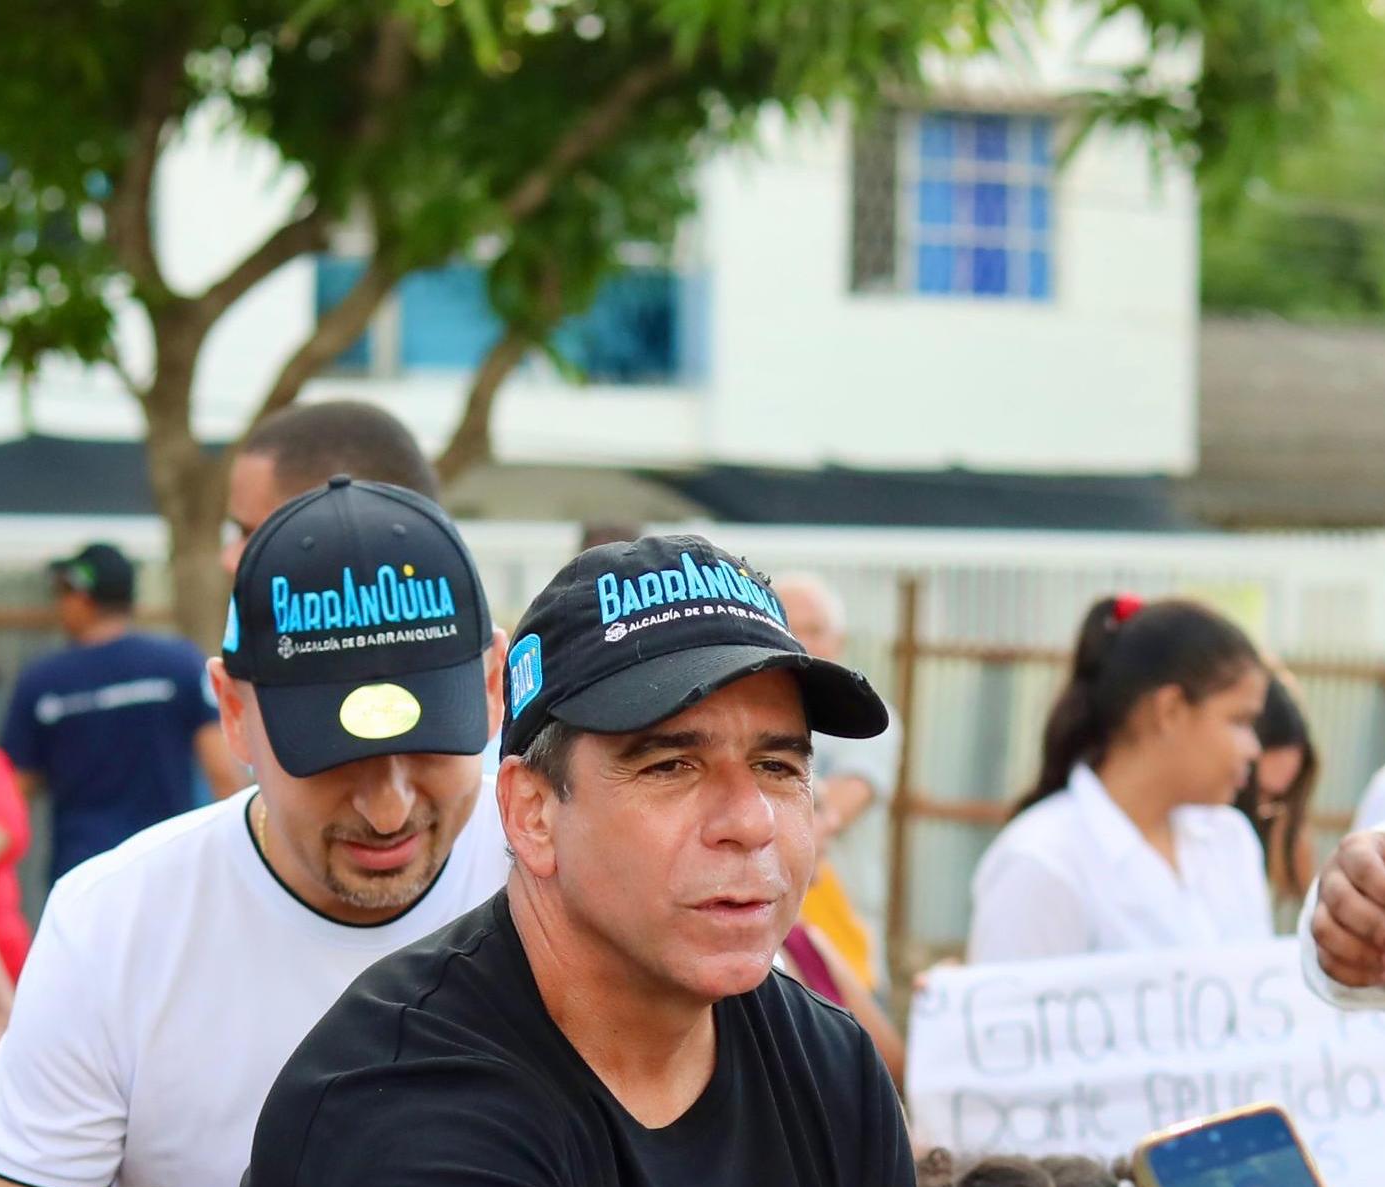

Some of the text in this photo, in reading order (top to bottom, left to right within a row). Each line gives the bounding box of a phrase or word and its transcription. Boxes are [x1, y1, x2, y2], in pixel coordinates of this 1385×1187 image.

[598, 552, 786, 625] BARRANQUILL
[342, 636, 355, 649] DE
[356, 623, 457, 648] BARRANQUILLA
[628, 608, 681, 633] ALCALDÍA
[685, 607, 700, 617] DE
[963, 966, 1297, 1076] Gracias
